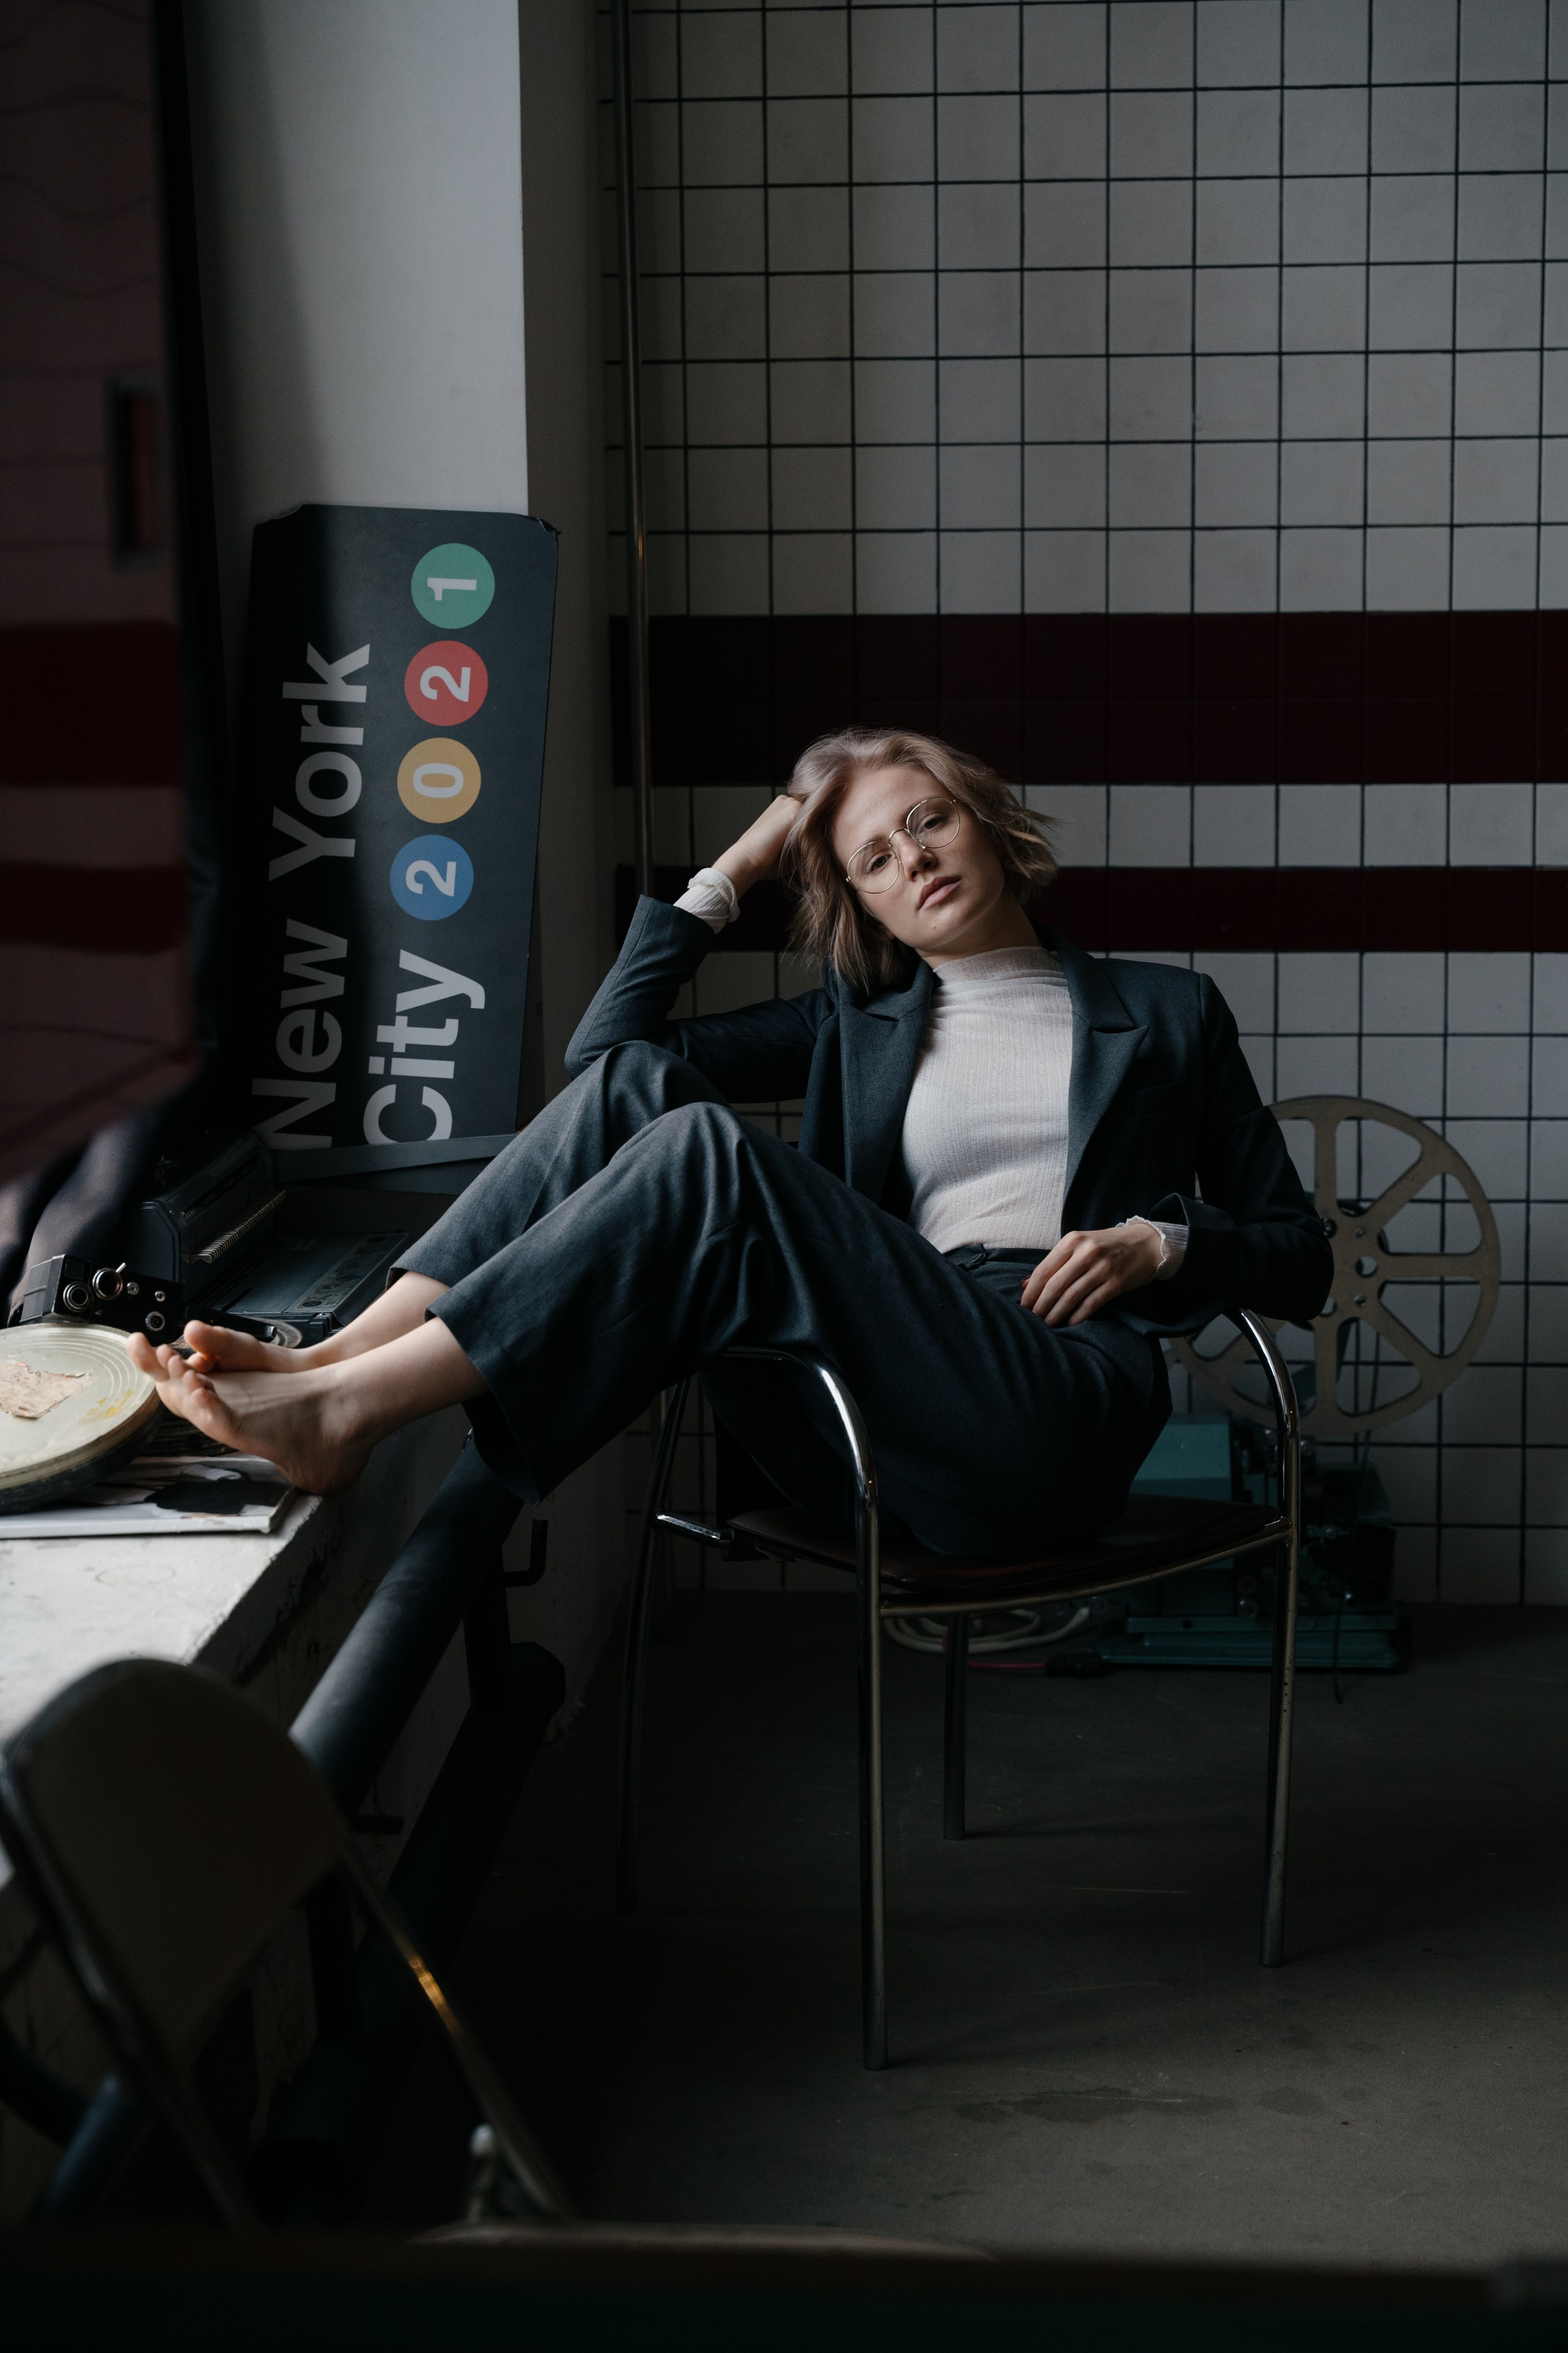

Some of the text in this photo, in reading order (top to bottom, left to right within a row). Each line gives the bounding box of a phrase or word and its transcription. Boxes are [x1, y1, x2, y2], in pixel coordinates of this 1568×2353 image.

[251, 642, 371, 1150] New York
[363, 949, 486, 1147] City
